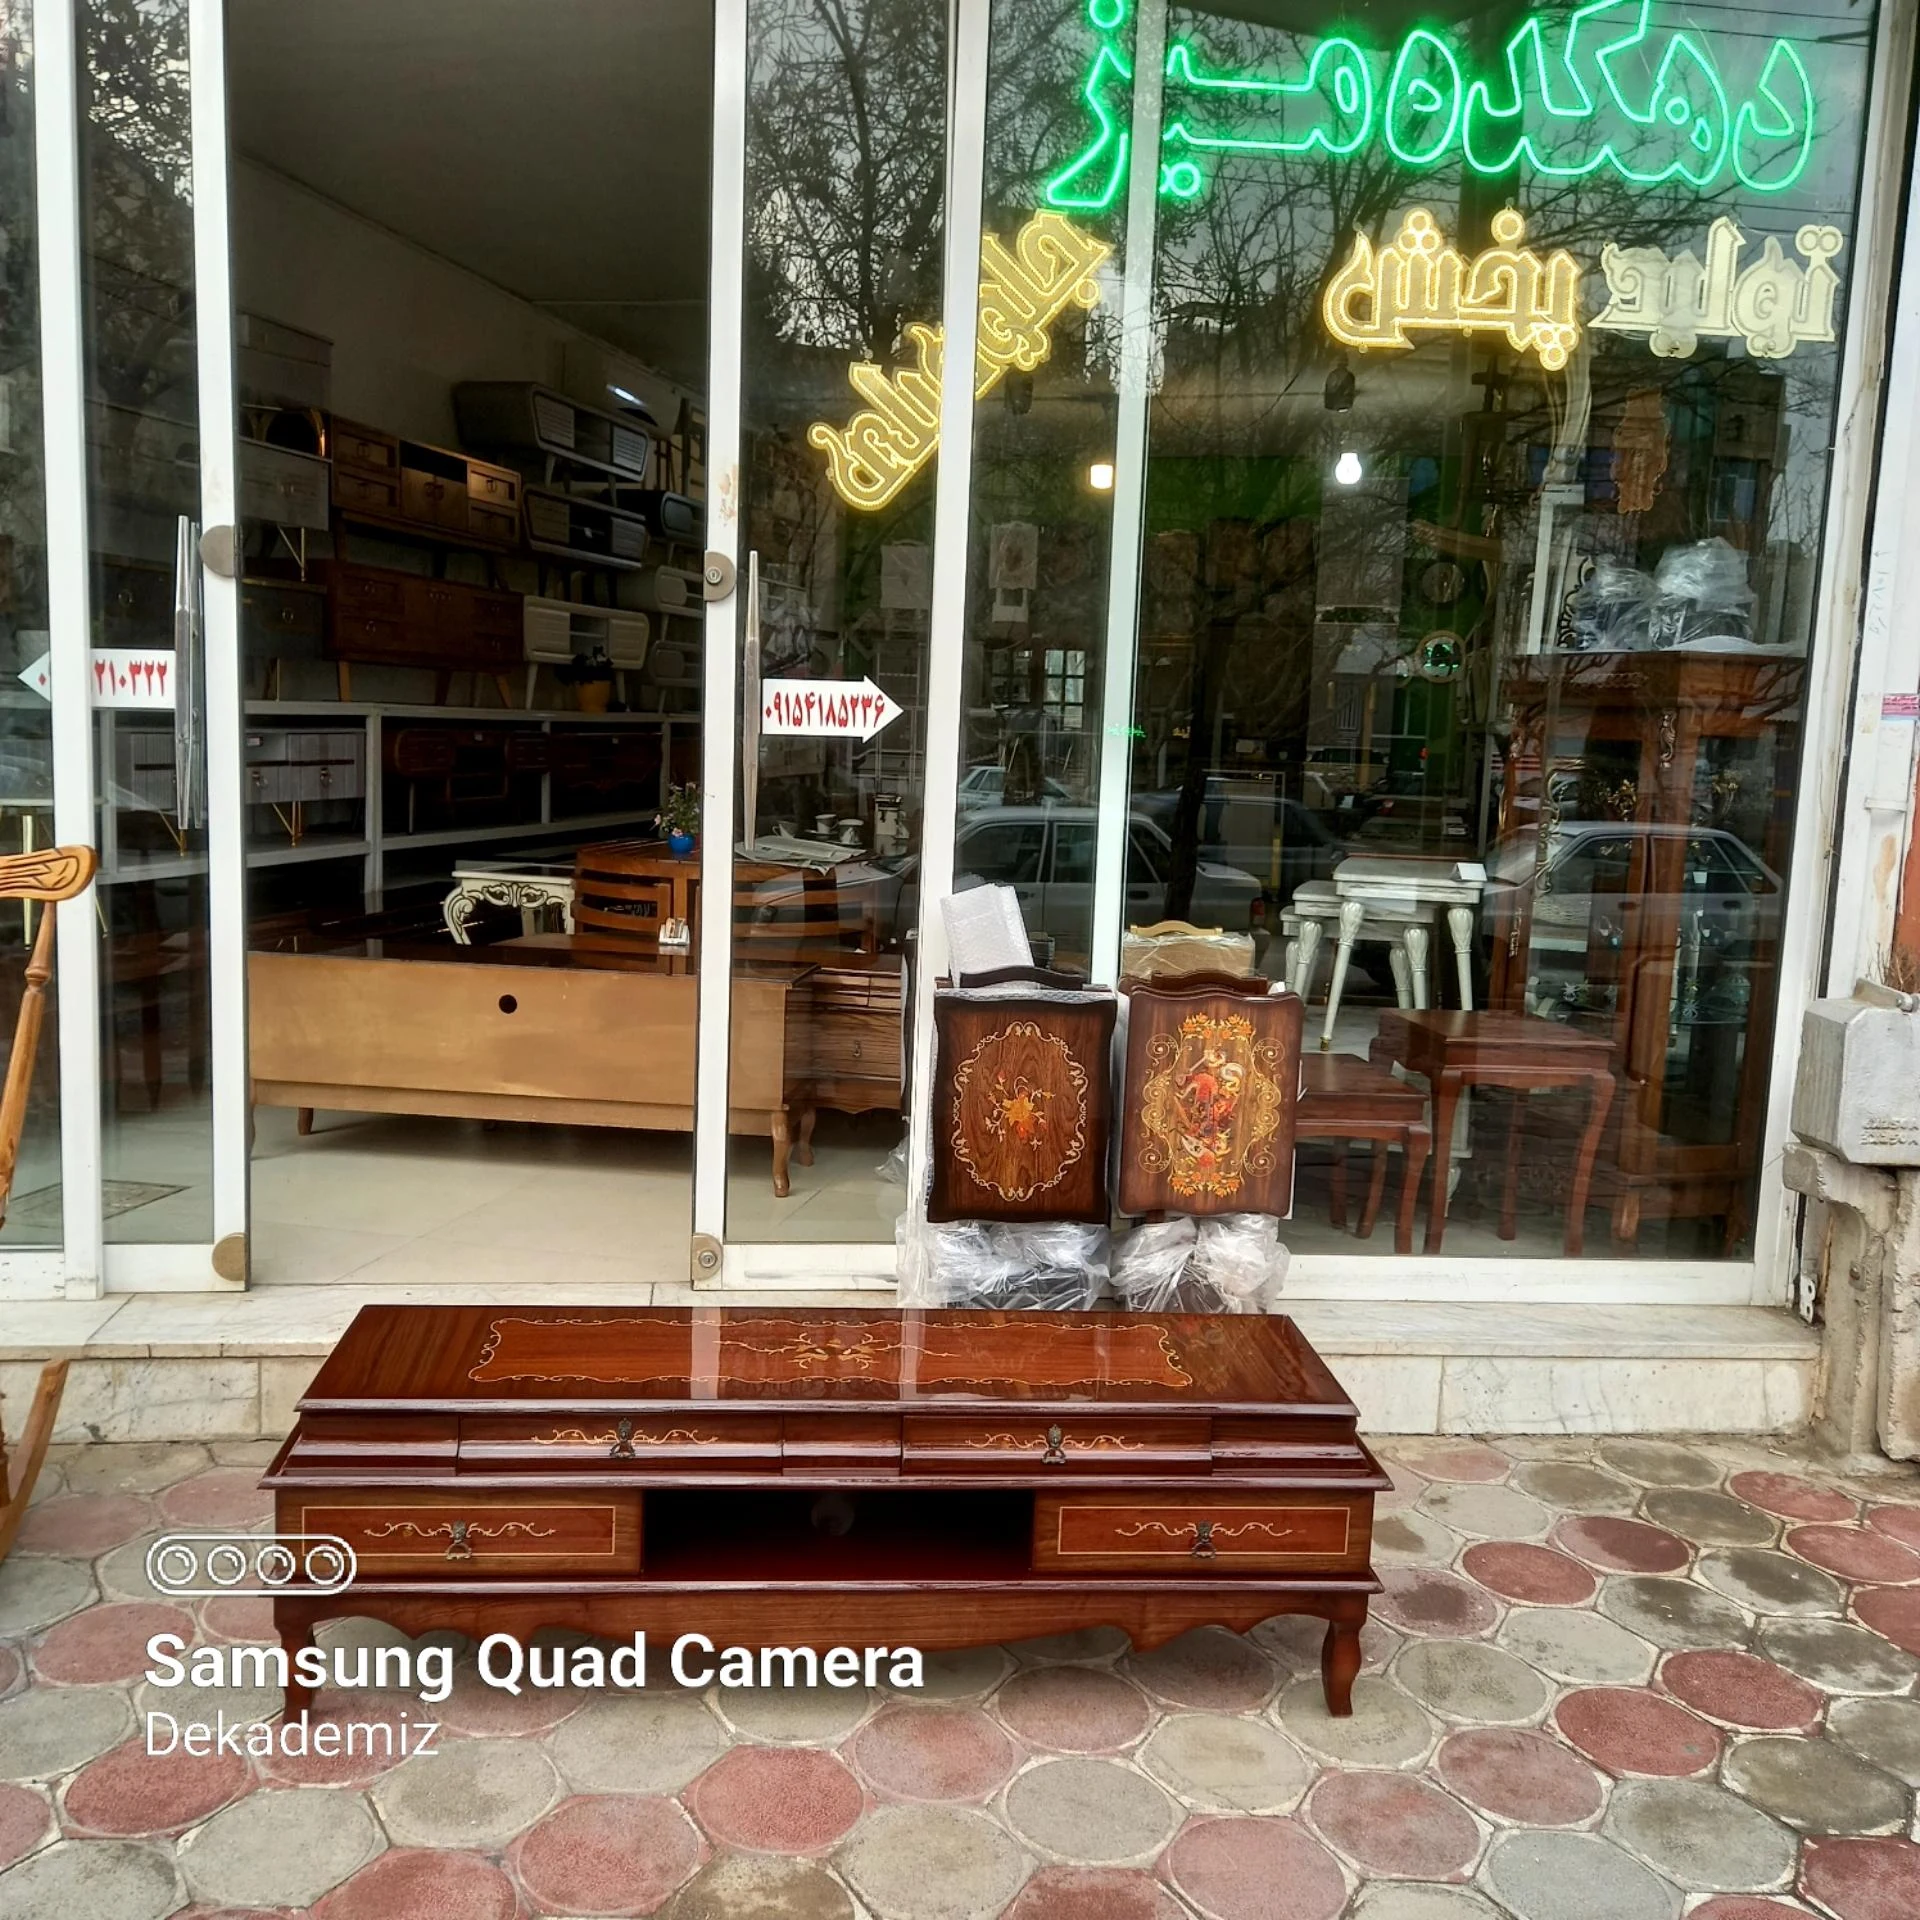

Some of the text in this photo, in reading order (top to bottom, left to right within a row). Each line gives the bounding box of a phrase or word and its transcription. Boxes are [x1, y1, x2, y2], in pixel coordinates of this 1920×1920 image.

[1045, 0, 1816, 209] دهکده میز
[1322, 204, 1842, 373] تولید پخش
[764, 690, 886, 729] ۰۹۱۵۴۱۸۵۲۳۶
